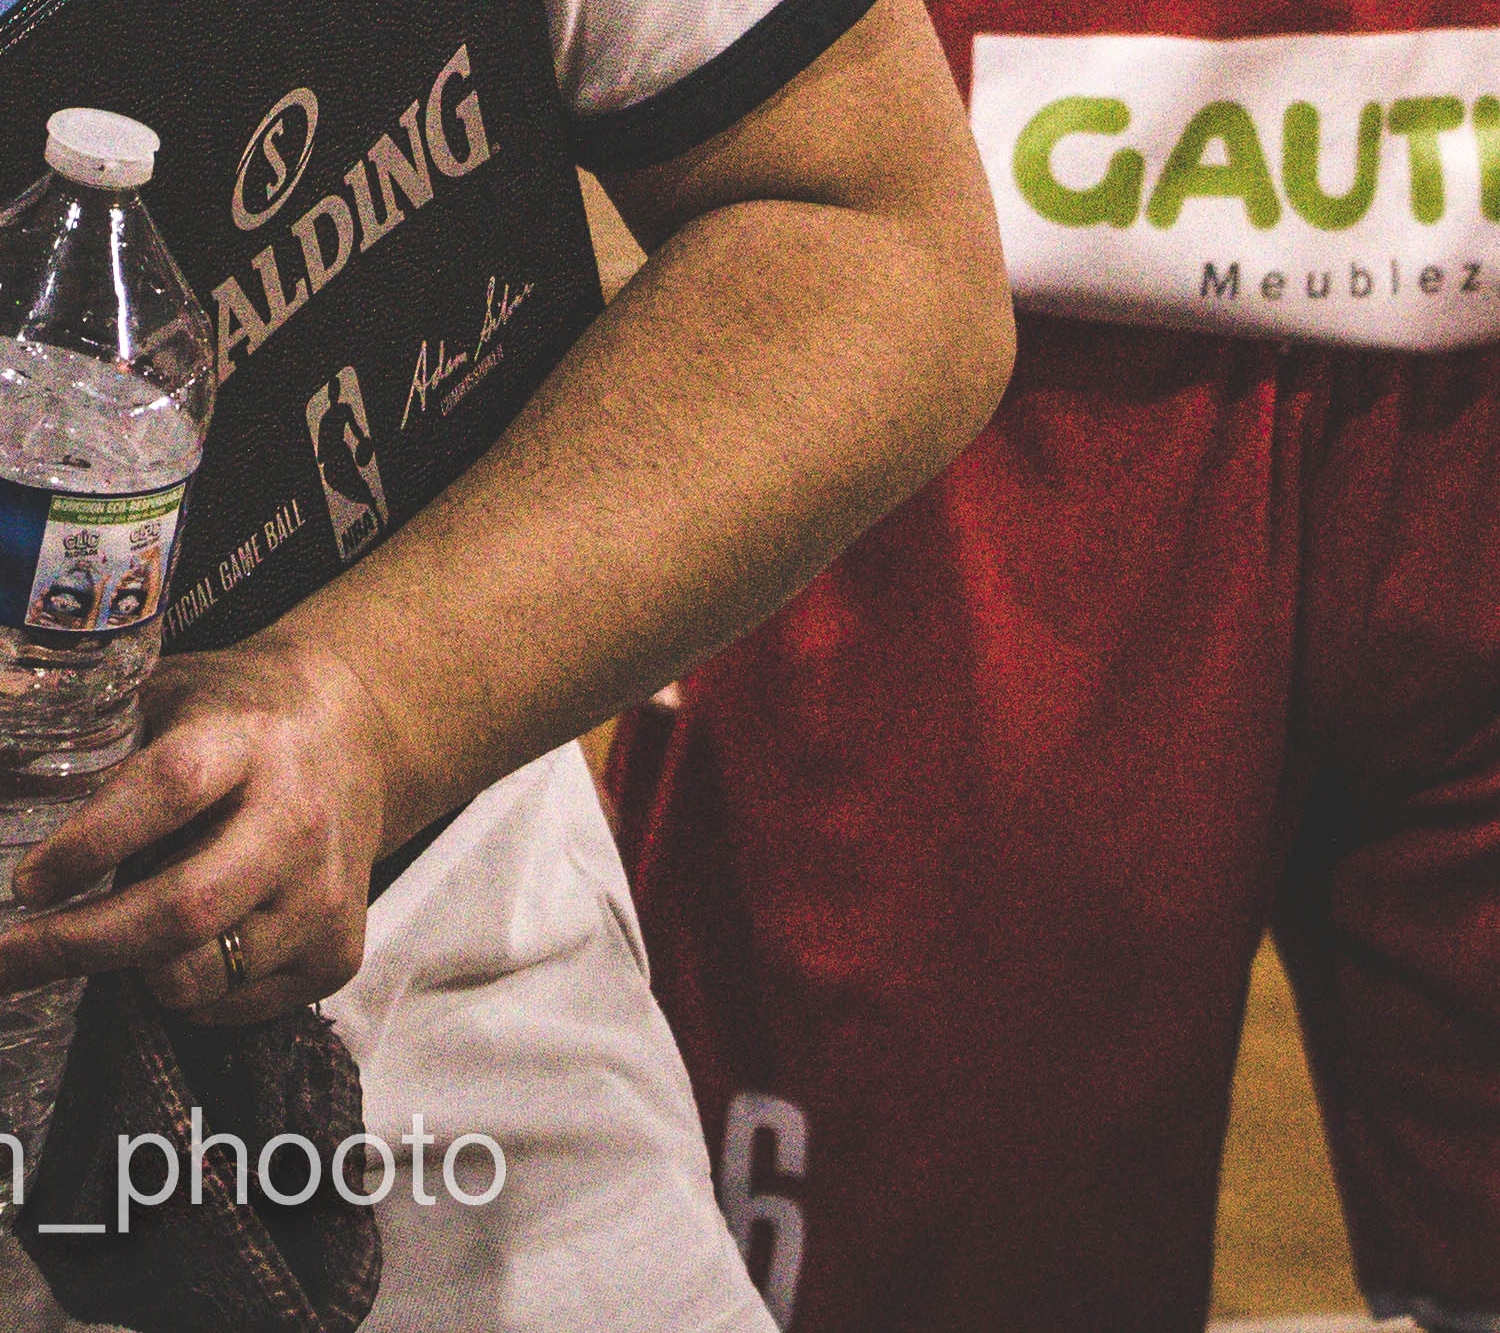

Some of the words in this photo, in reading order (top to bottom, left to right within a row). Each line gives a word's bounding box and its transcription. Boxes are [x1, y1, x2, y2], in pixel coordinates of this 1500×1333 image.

[211, 42, 491, 384] ALDING
[219, 533, 264, 592] GAME
[263, 498, 306, 553] BALL
[722, 1090, 809, 1332] 6
